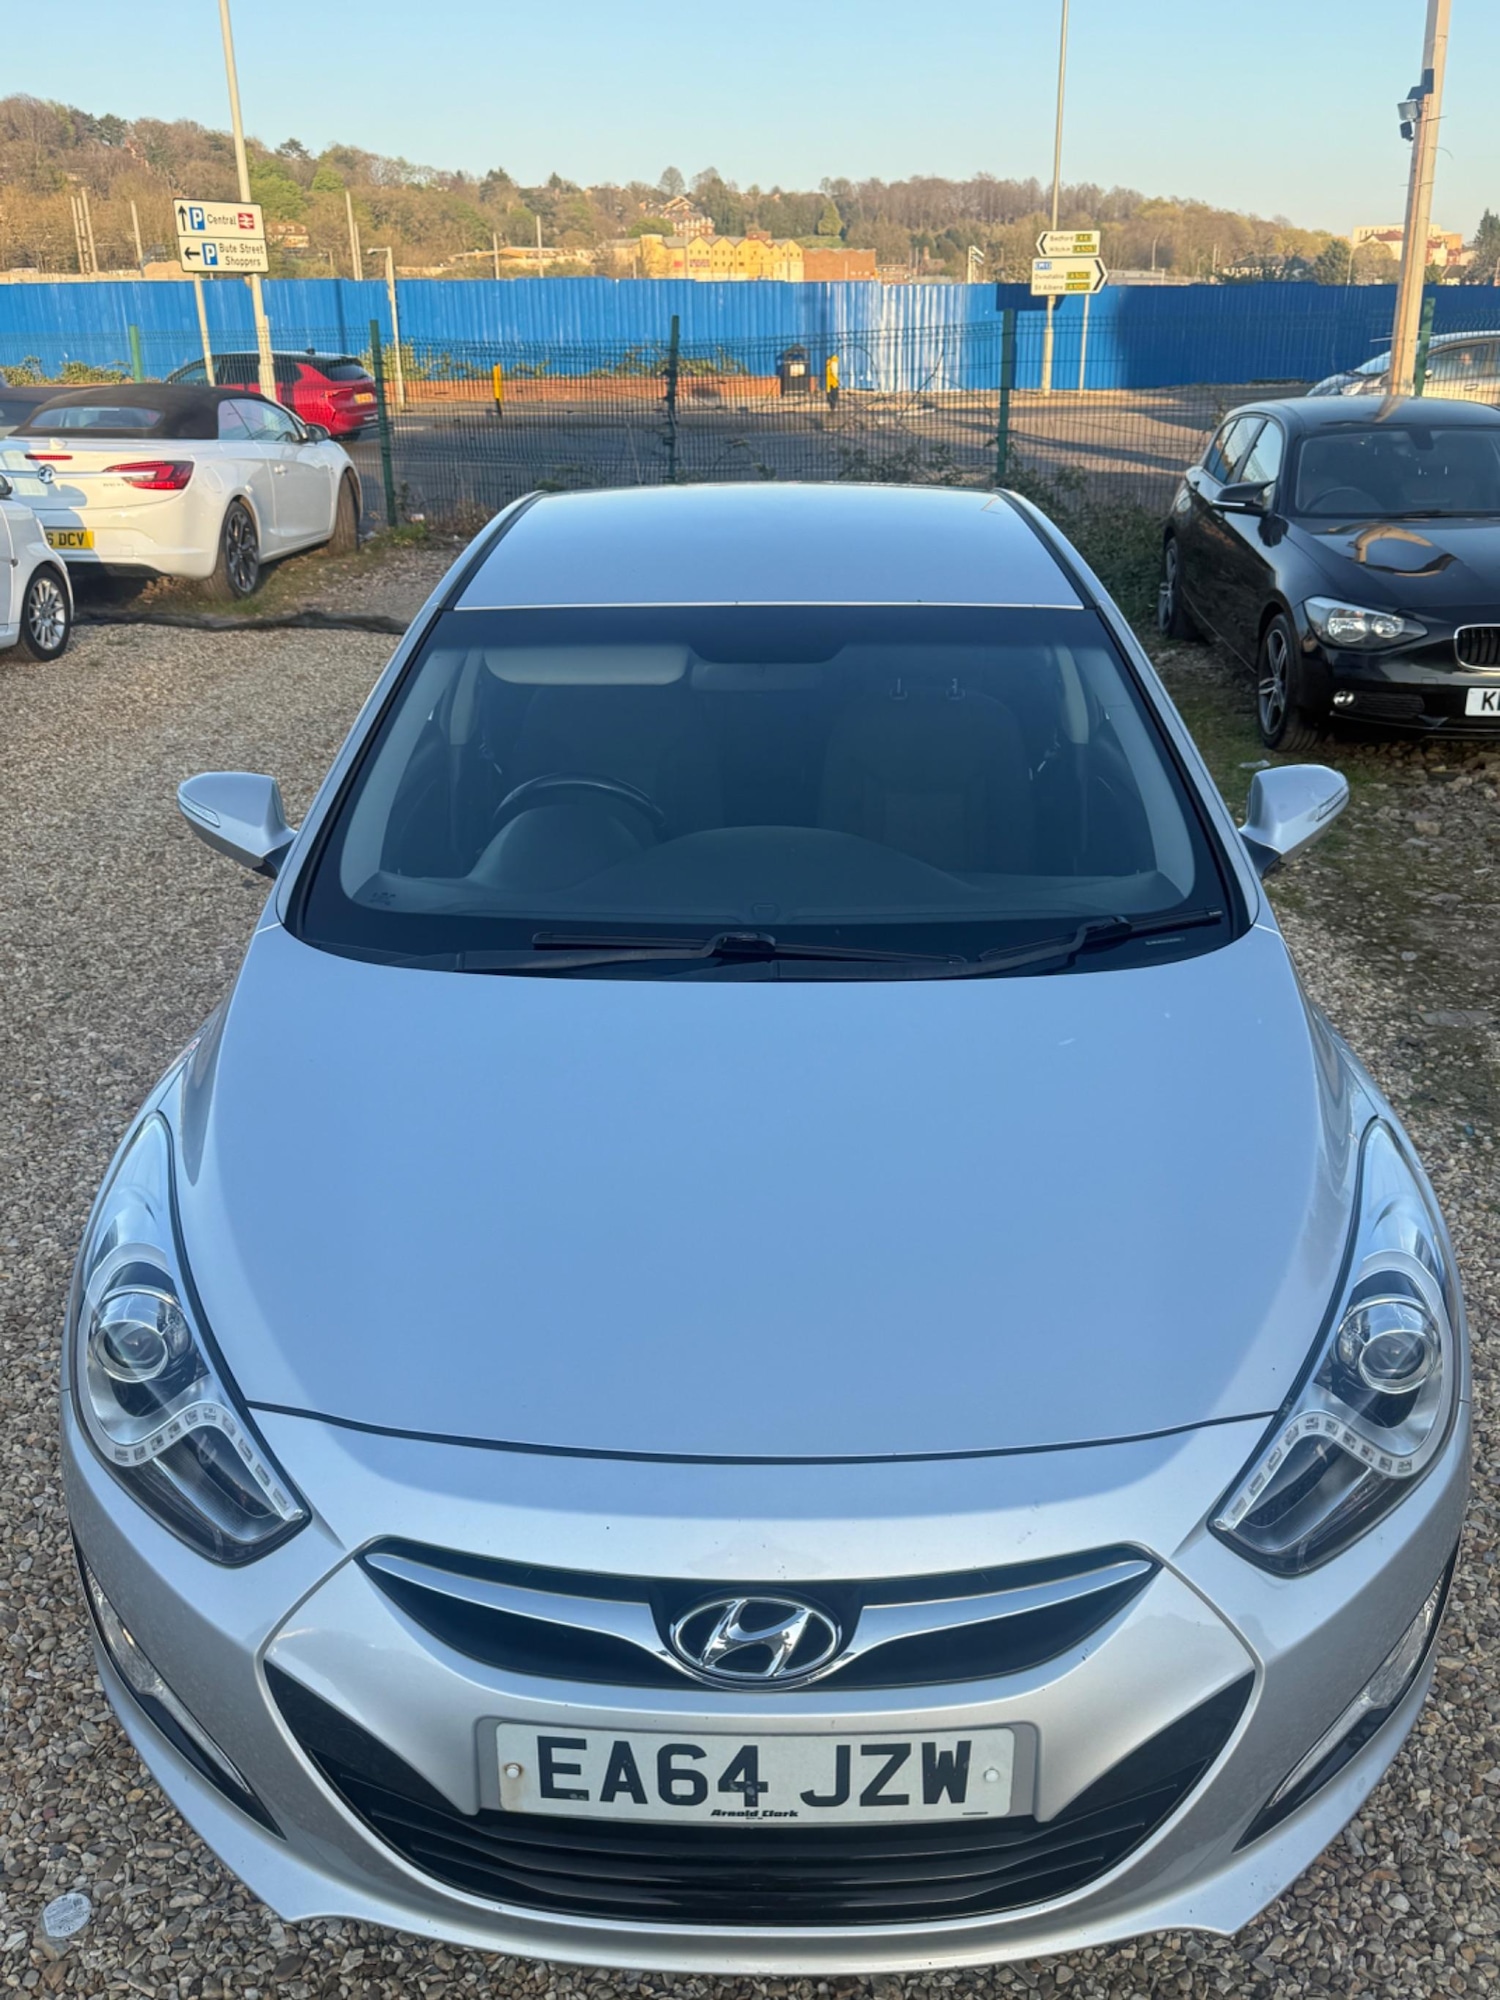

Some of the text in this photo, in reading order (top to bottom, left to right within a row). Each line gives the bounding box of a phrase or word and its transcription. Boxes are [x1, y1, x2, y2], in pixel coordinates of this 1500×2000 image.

[206, 214, 236, 225] Central
[219, 243, 238, 253] Bute
[240, 244, 264, 254] Street
[225, 256, 261, 267] Shoppers
[58, 532, 85, 546] DCV
[537, 1735, 972, 1808] EA64 JZW
[710, 1809, 799, 1818] Arnold Clark
